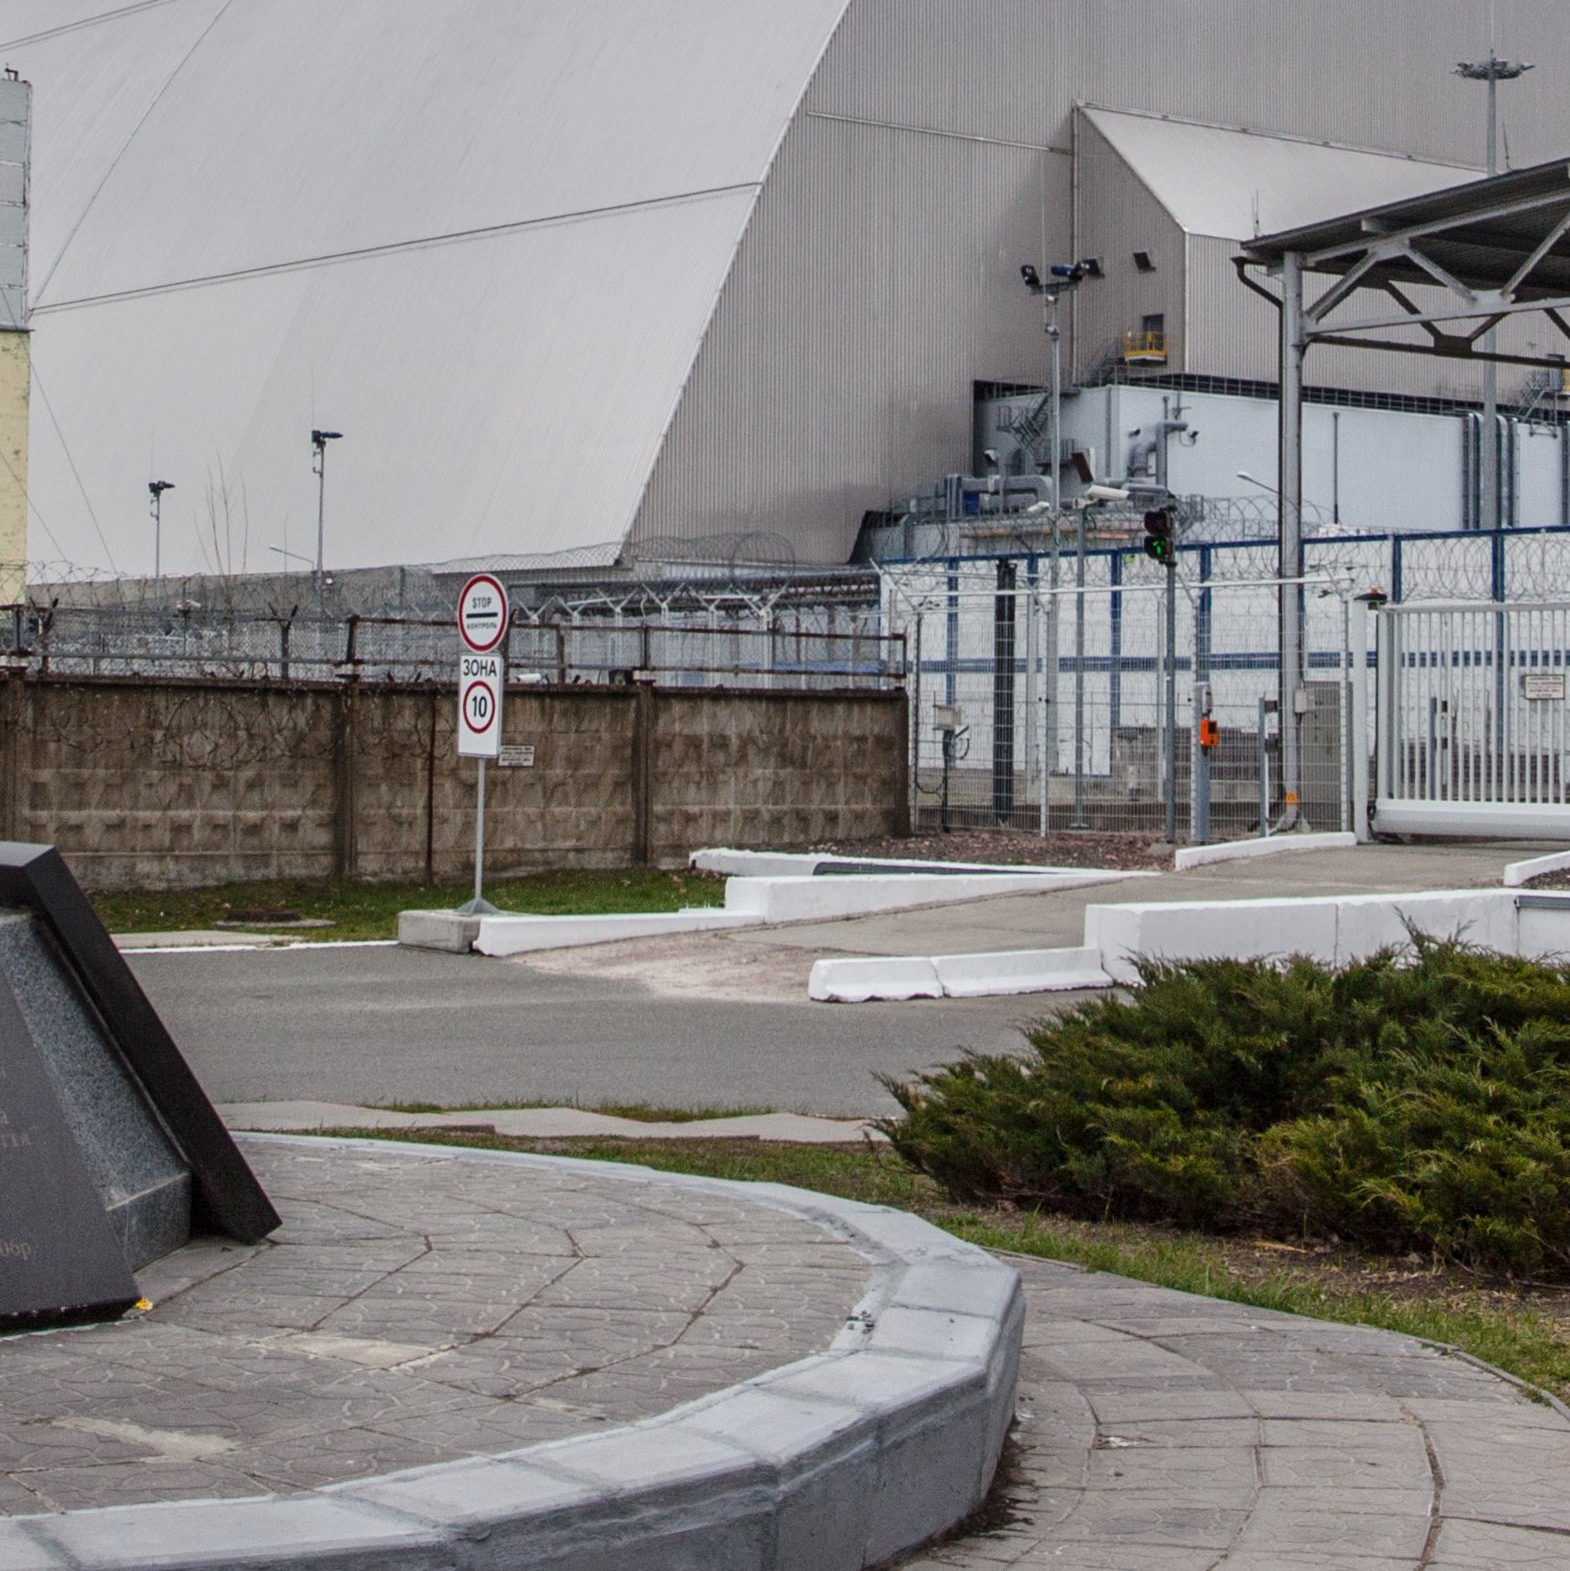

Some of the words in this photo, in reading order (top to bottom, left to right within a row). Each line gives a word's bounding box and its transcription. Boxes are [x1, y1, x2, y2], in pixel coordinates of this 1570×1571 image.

[472, 597, 492, 609] STOP
[467, 622, 497, 630] КОНТРОЛЬ
[463, 659, 497, 677] ЗОНА
[472, 695, 488, 718] 10
